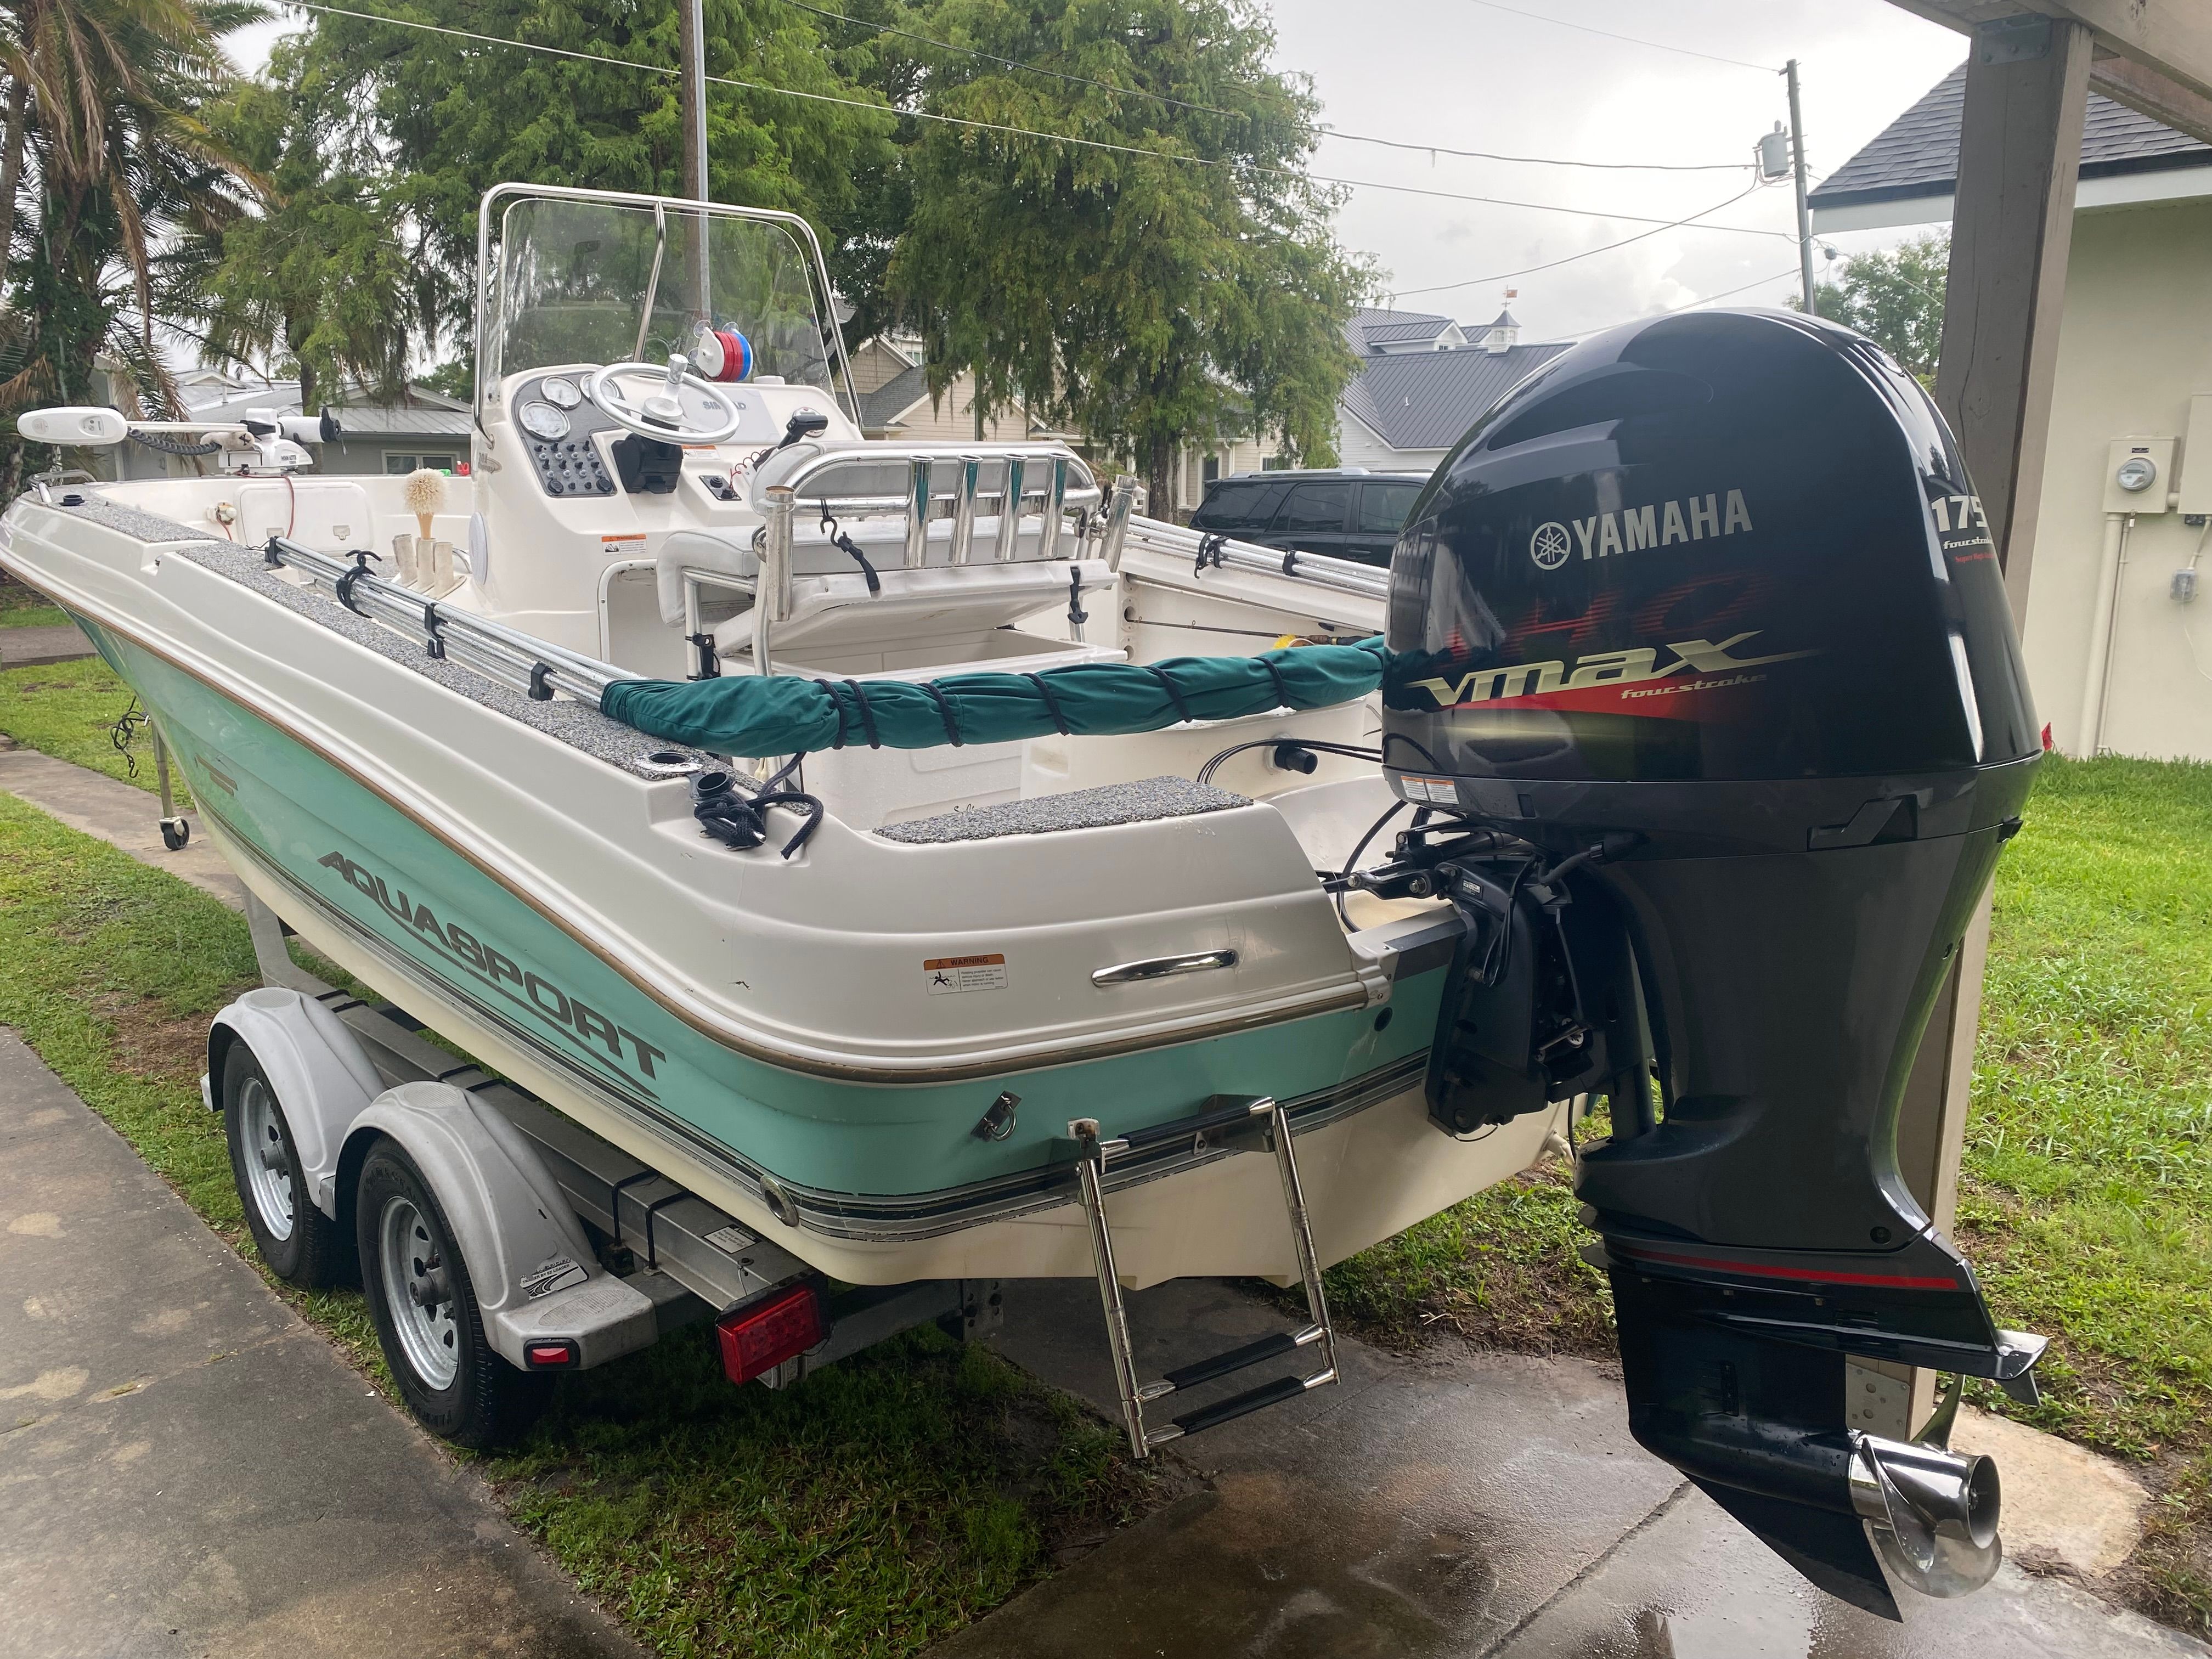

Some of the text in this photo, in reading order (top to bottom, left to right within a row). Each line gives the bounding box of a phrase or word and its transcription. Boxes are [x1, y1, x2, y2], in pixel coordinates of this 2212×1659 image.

[1572, 488, 1753, 561] YAMAHA
[1931, 495, 1988, 532] 175
[317, 850, 667, 1081] AQUASPORT
[950, 956, 989, 966] WARNING
[552, 1264, 570, 1273] LOADER
